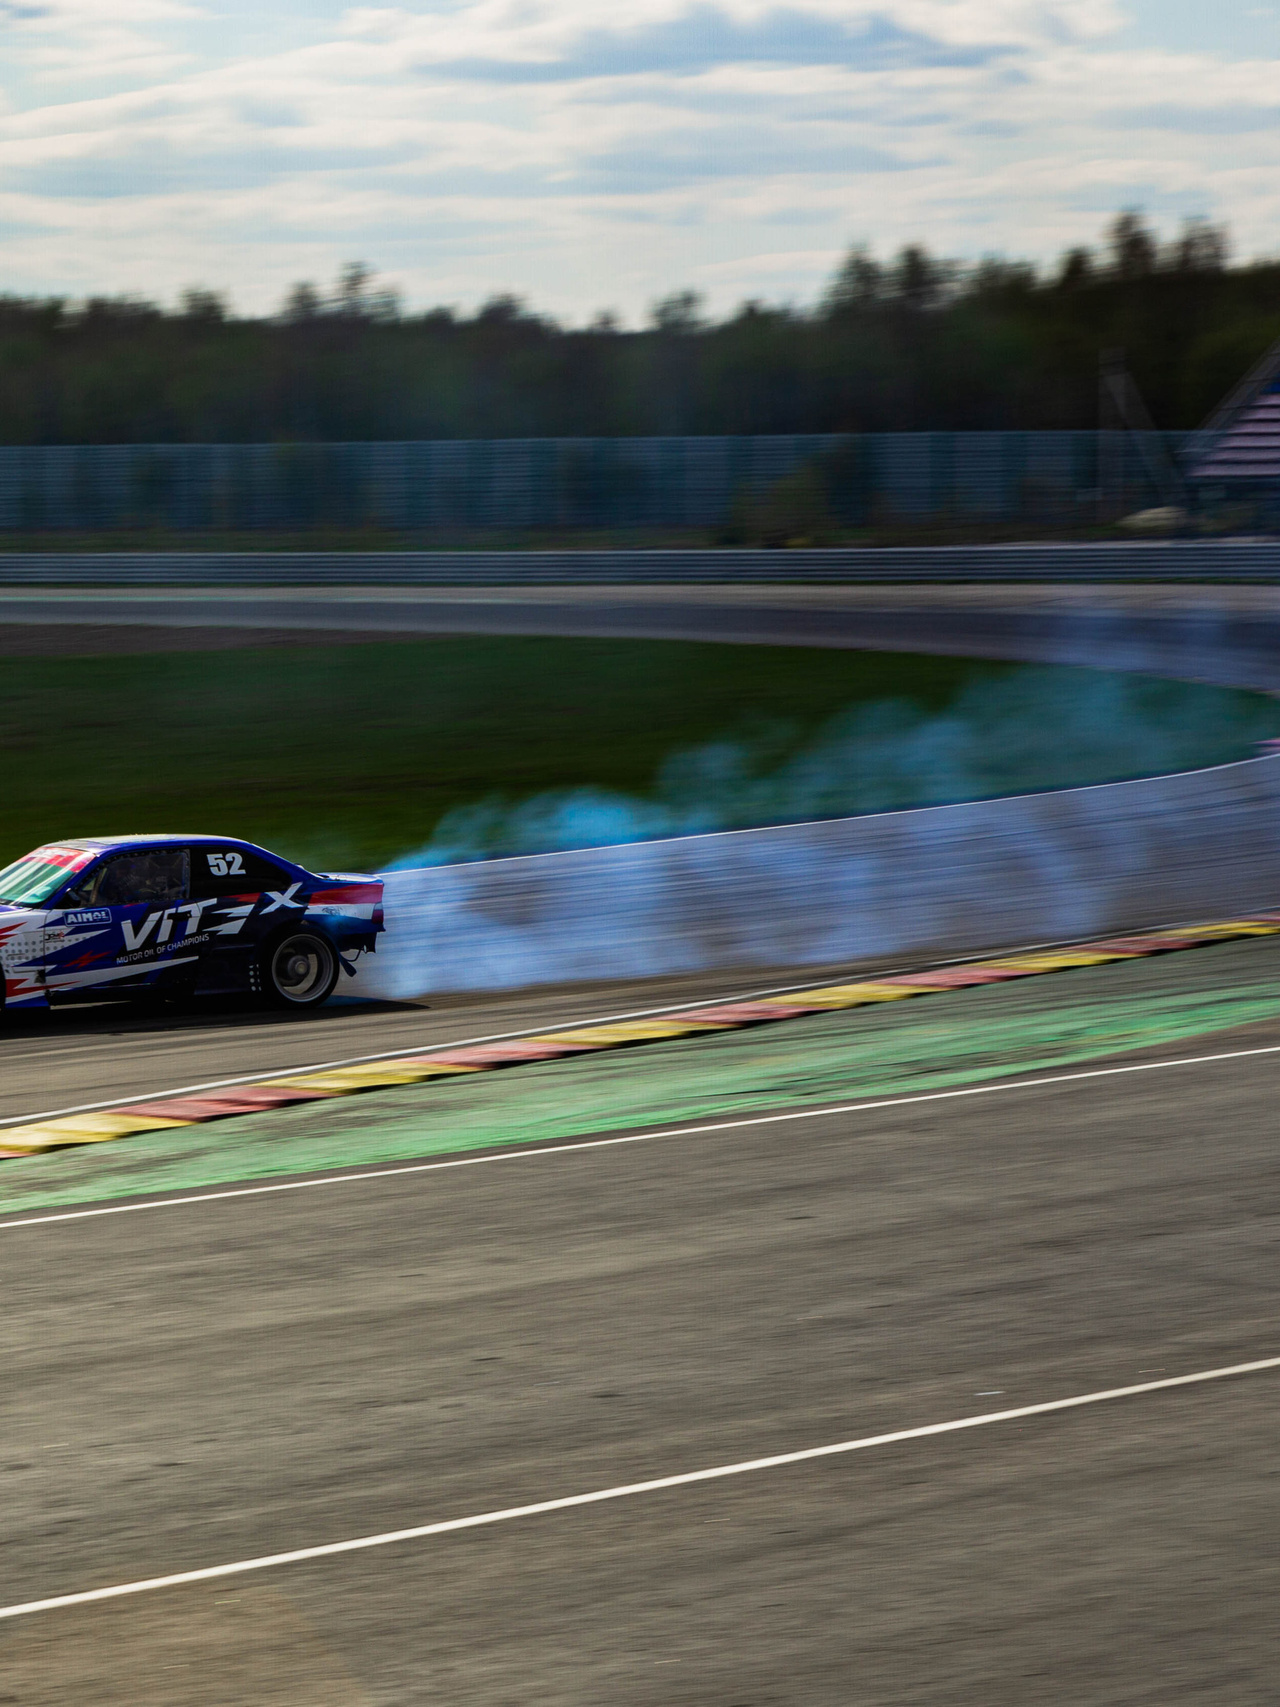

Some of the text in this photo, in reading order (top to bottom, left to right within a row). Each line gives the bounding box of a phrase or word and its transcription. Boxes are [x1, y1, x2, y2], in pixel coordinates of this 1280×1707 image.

[206, 852, 246, 876] 52
[67, 911, 109, 924] AIMOL
[116, 934, 209, 964] MOTOR OIL OF CHAMPIONS
